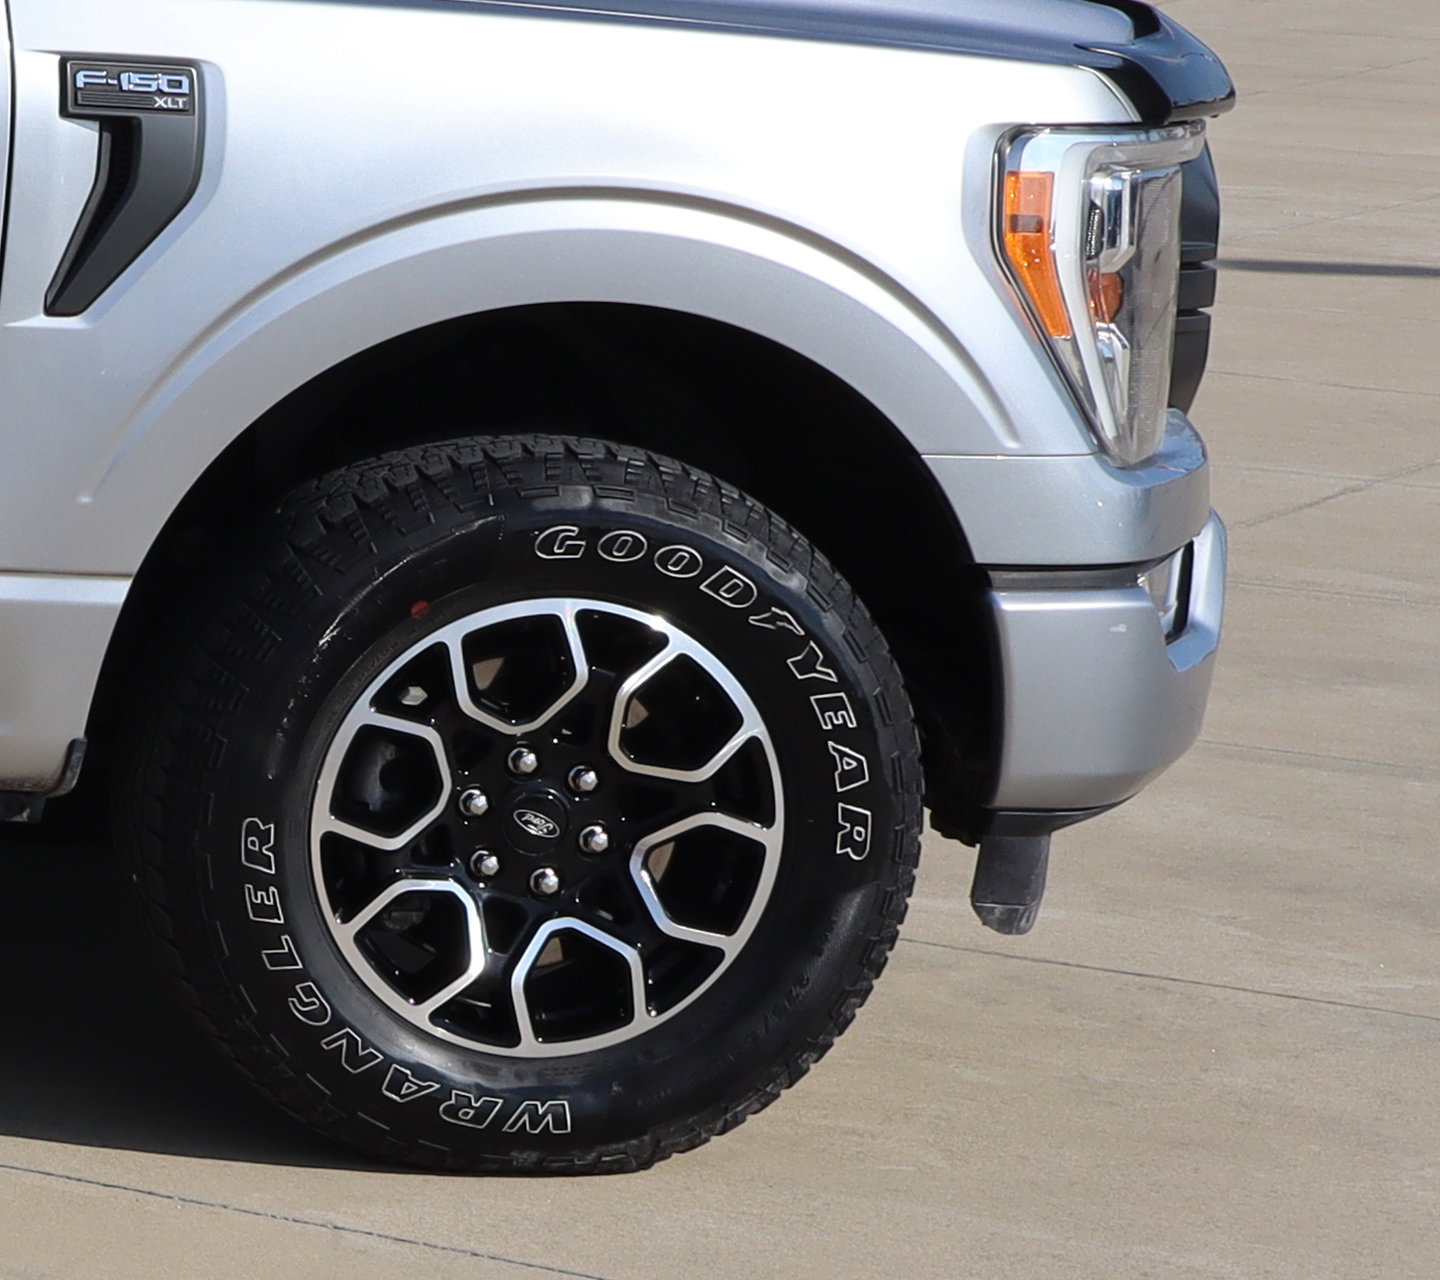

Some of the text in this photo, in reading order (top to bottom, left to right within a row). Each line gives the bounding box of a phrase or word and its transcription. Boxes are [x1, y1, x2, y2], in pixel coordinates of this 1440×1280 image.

[75, 70, 190, 95] F-150
[153, 96, 188, 109] XLT
[535, 525, 872, 861] GOODYEAR
[241, 817, 571, 1134] WRANGLER
